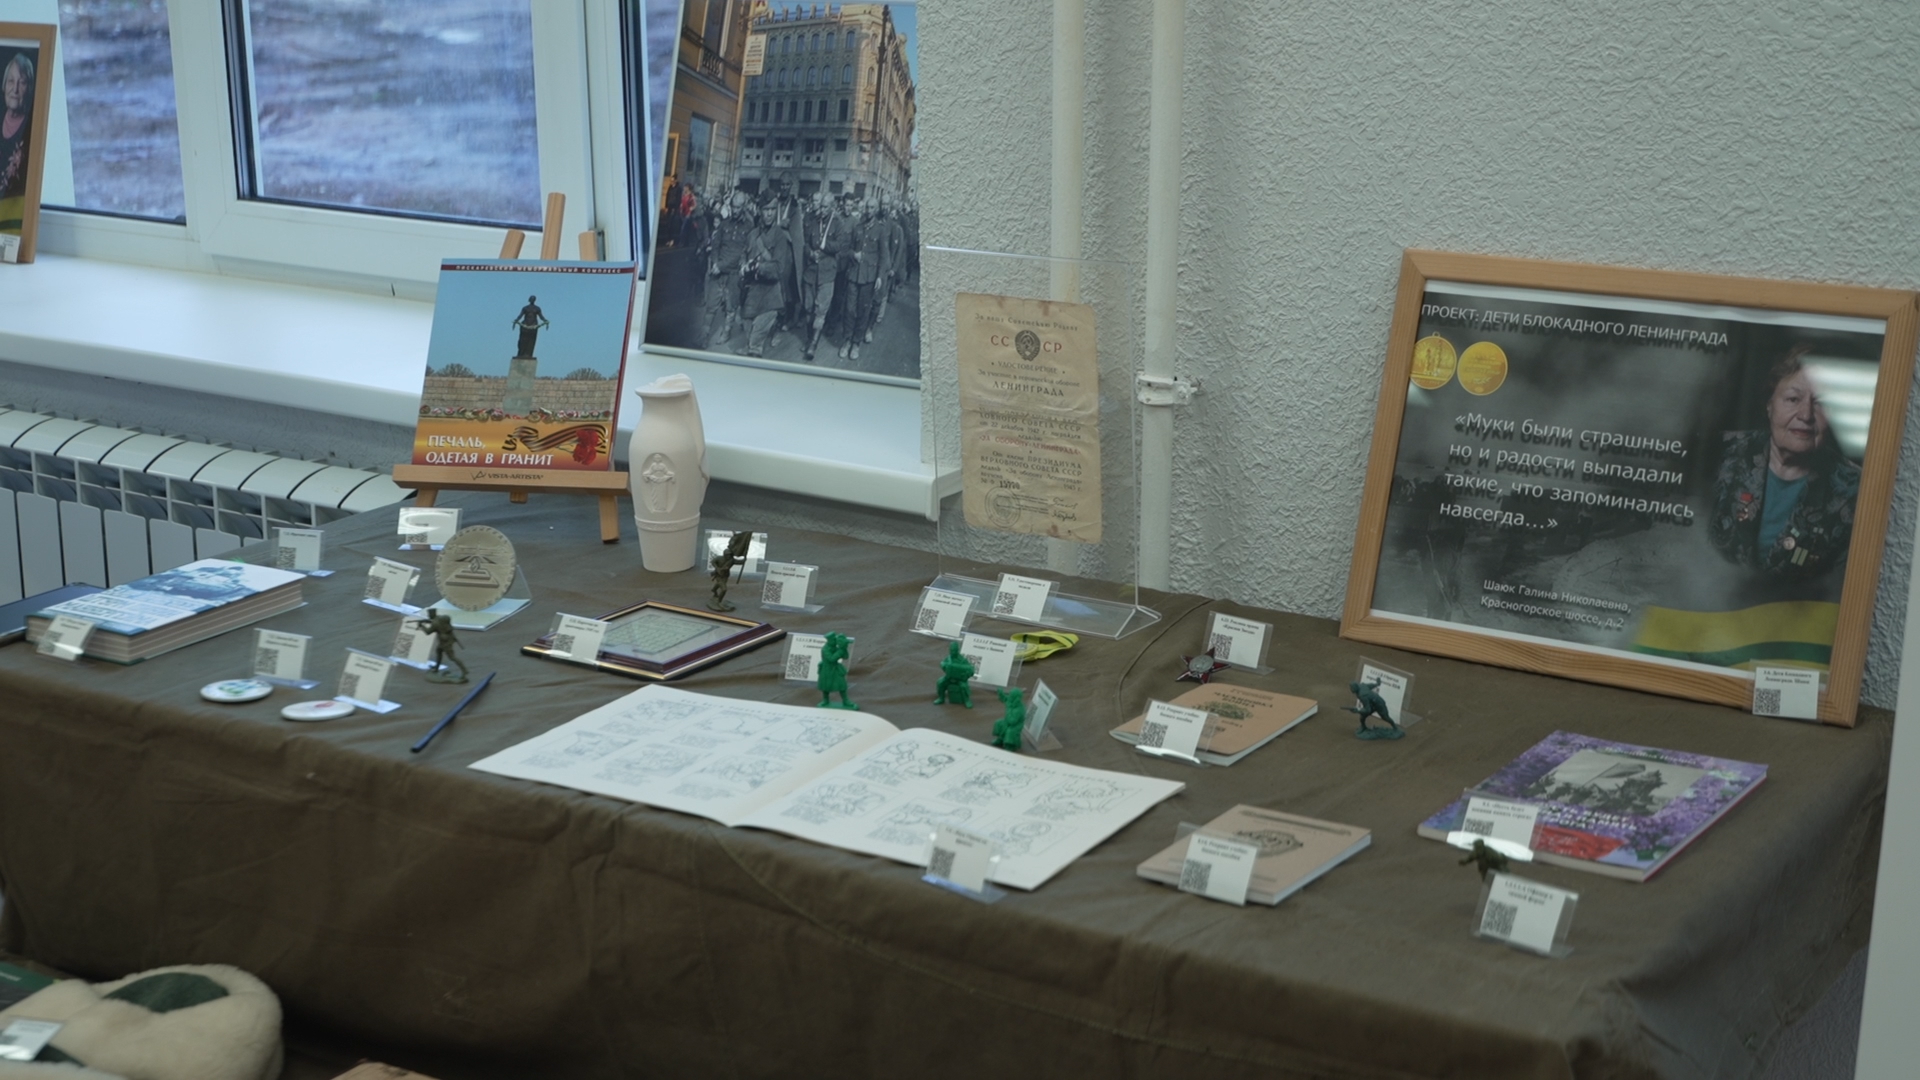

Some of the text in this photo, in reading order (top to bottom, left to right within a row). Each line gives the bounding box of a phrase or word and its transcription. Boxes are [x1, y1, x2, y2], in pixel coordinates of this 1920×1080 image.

[1421, 304, 1728, 346] ПРОЕКТ: ДЕТИ БЛОКАДНОГО ЛЕНИНГРАДА
[993, 381, 1064, 397] ЛЕНИНГРАДА
[427, 435, 487, 450] ПЕЧАЛЬ,
[1059, 423, 1081, 433] СССР
[1455, 412, 1688, 457] «Муки были страшные,
[425, 451, 554, 466] ОДЕТАЯ В ГРАНИТ
[1450, 443, 1683, 485] но и радости выпадали
[1444, 473, 1695, 518] такие, что запоминались
[1481, 596, 1624, 628] Красногорское шоссе, д.2
[1483, 580, 1632, 613] Шаюк Галина Николаевна,
